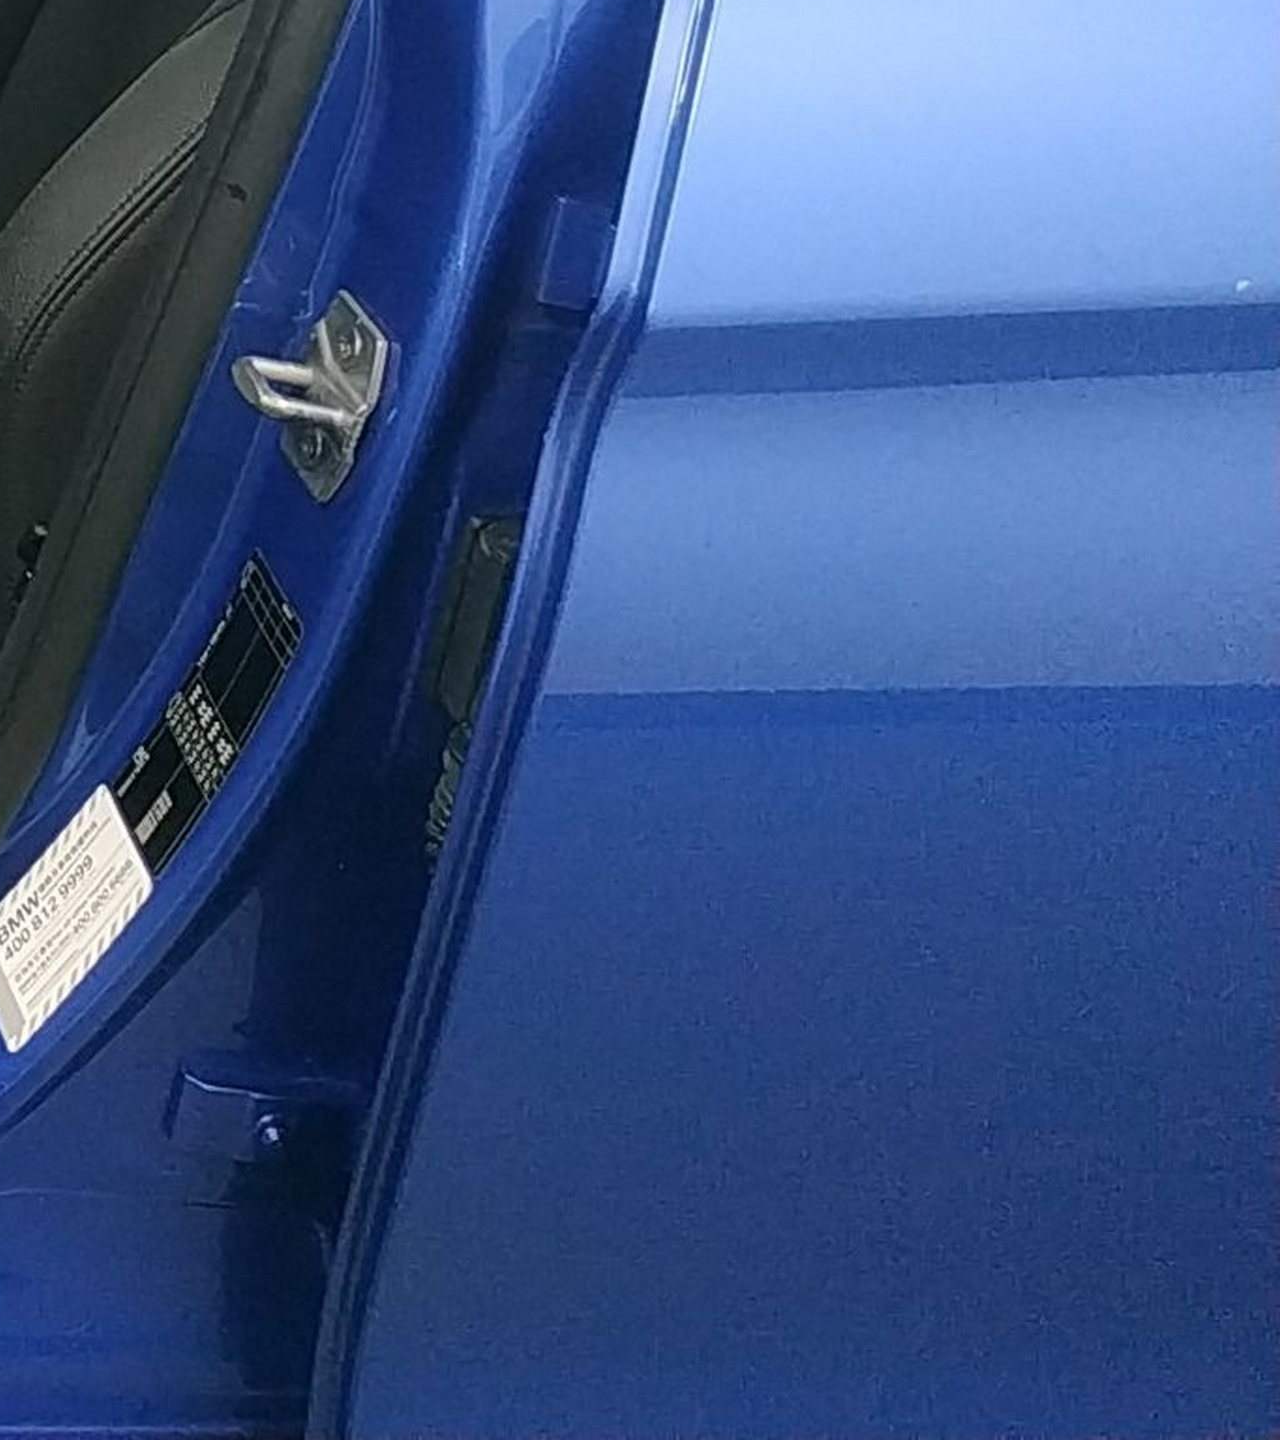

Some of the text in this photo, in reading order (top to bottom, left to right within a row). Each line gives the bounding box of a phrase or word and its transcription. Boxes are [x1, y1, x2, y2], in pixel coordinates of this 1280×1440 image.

[3, 929, 32, 961] 400
[34, 897, 59, 930] 812
[59, 855, 94, 899] 9999
